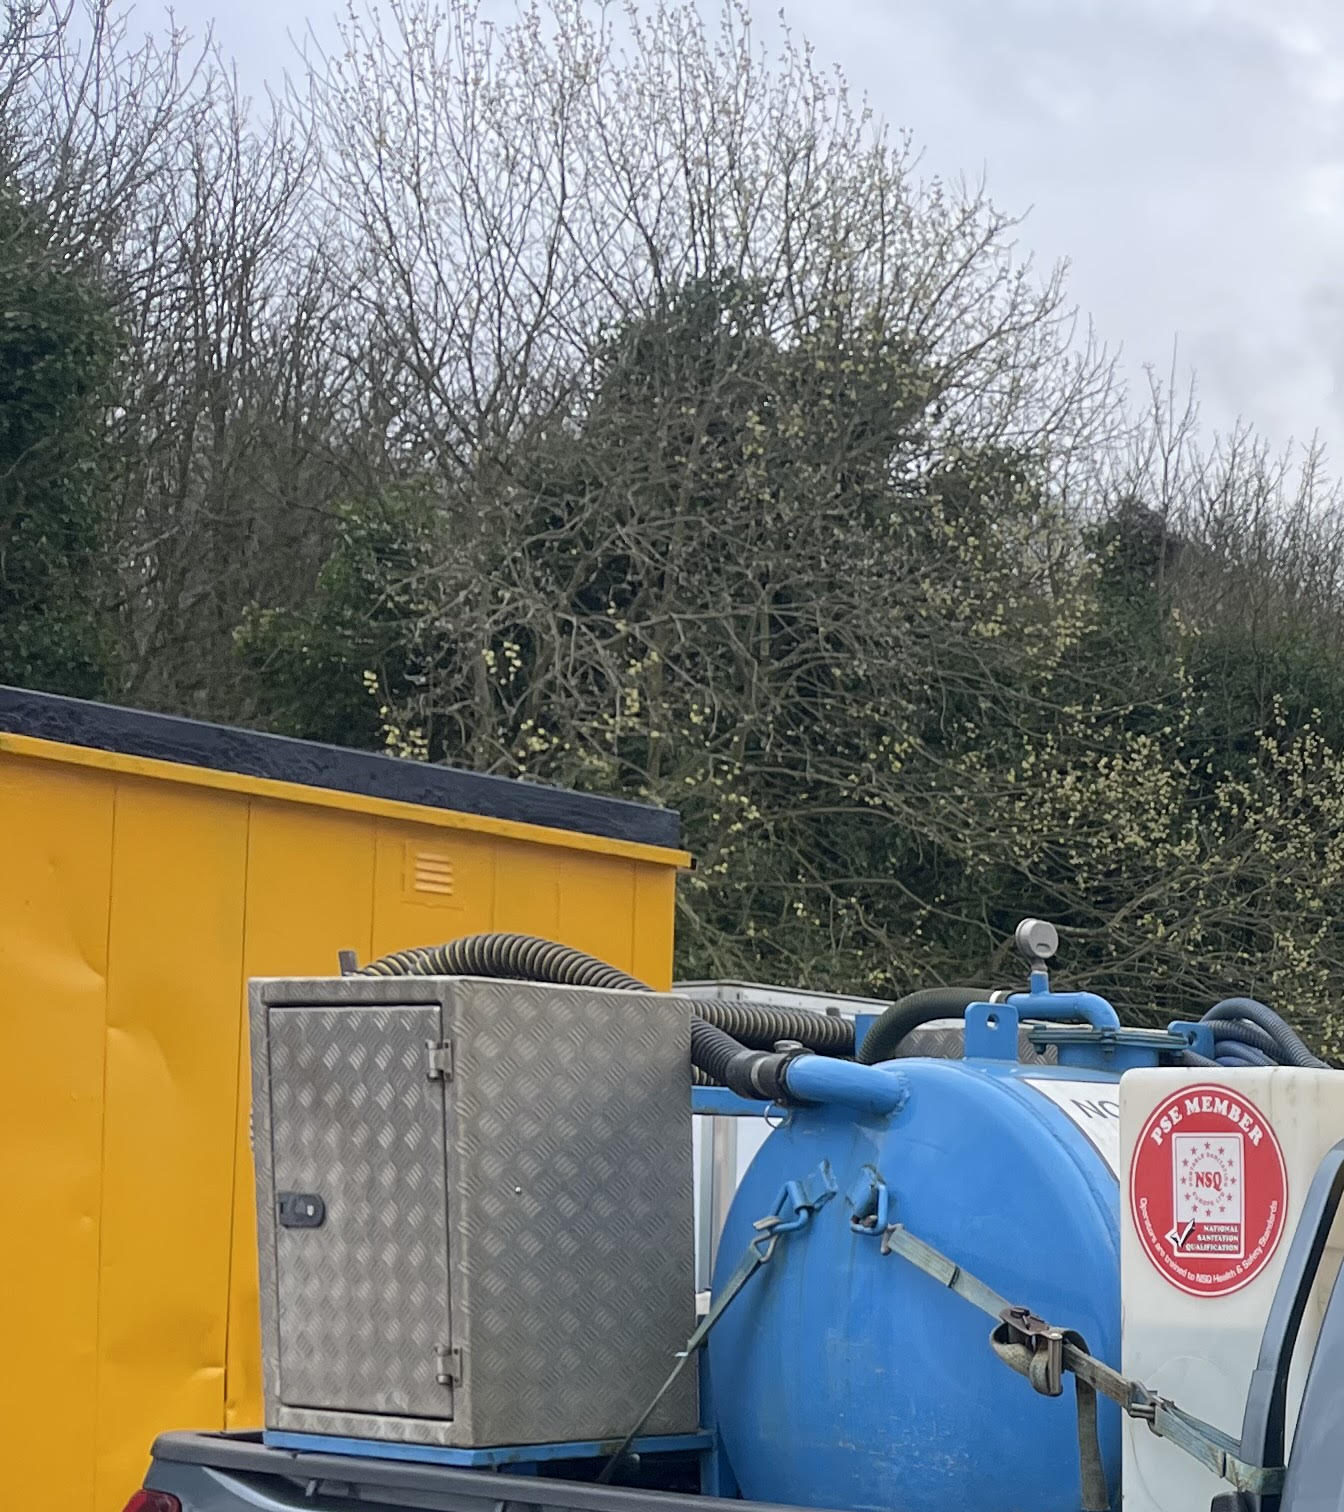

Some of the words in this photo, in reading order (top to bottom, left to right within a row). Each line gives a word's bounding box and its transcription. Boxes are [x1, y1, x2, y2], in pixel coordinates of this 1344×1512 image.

[1150, 1105, 1183, 1147] PSE
[1184, 1095, 1263, 1147] MEMBER
[1194, 1171, 1222, 1191] NSQ
[1203, 1225, 1239, 1233] NATIONAL
[1139, 1197, 1157, 1244] Operators
[1155, 1242, 1166, 1258] are
[1164, 1254, 1188, 1277] trained
[1187, 1271, 1196, 1281] to
[1212, 1268, 1237, 1283] Health
[1235, 1264, 1243, 1274] &
[1242, 1246, 1263, 1269] Safety
[1257, 1200, 1278, 1248] Standards
[1197, 1234, 1239, 1242] SANITATION
[1185, 1244, 1239, 1252] QUALIFICATION
